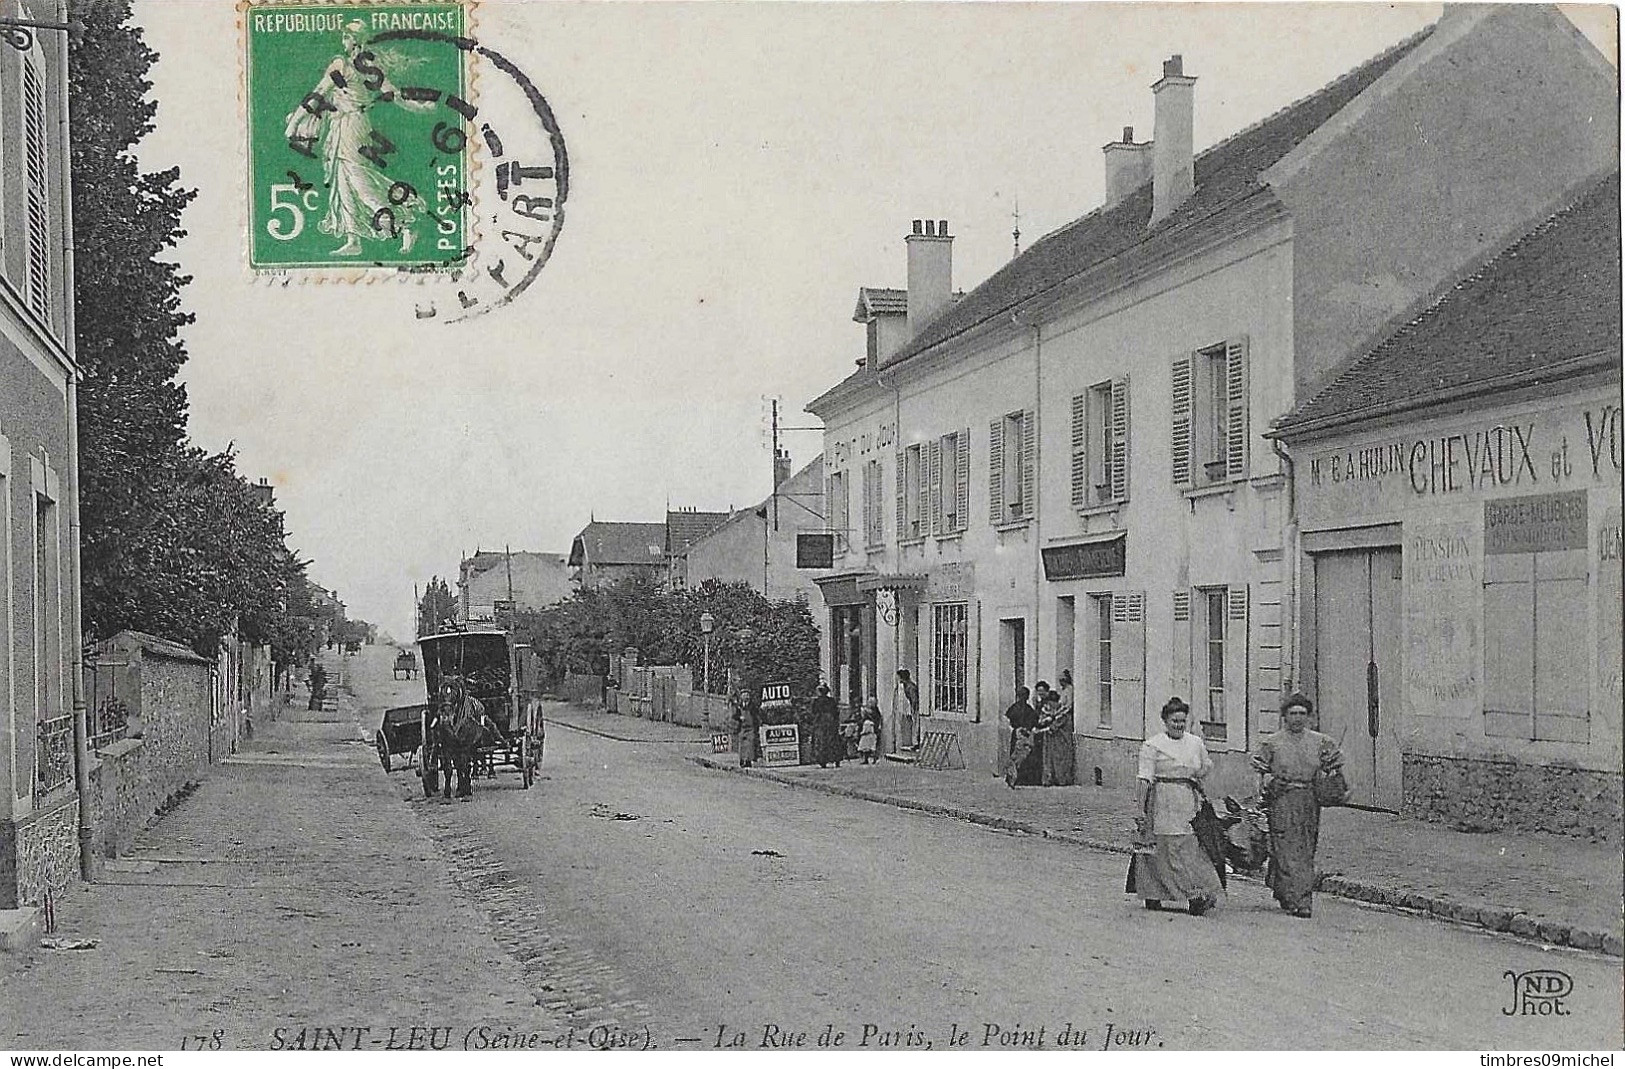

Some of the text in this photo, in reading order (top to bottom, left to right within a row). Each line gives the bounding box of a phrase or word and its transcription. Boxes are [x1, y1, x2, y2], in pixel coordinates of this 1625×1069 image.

[436, 164, 459, 251] POSTES
[1408, 424, 1537, 494] CHEVAUX
[1412, 536, 1470, 561] PENSION
[762, 685, 790, 699] AUTO
[769, 729, 793, 737] AUTO
